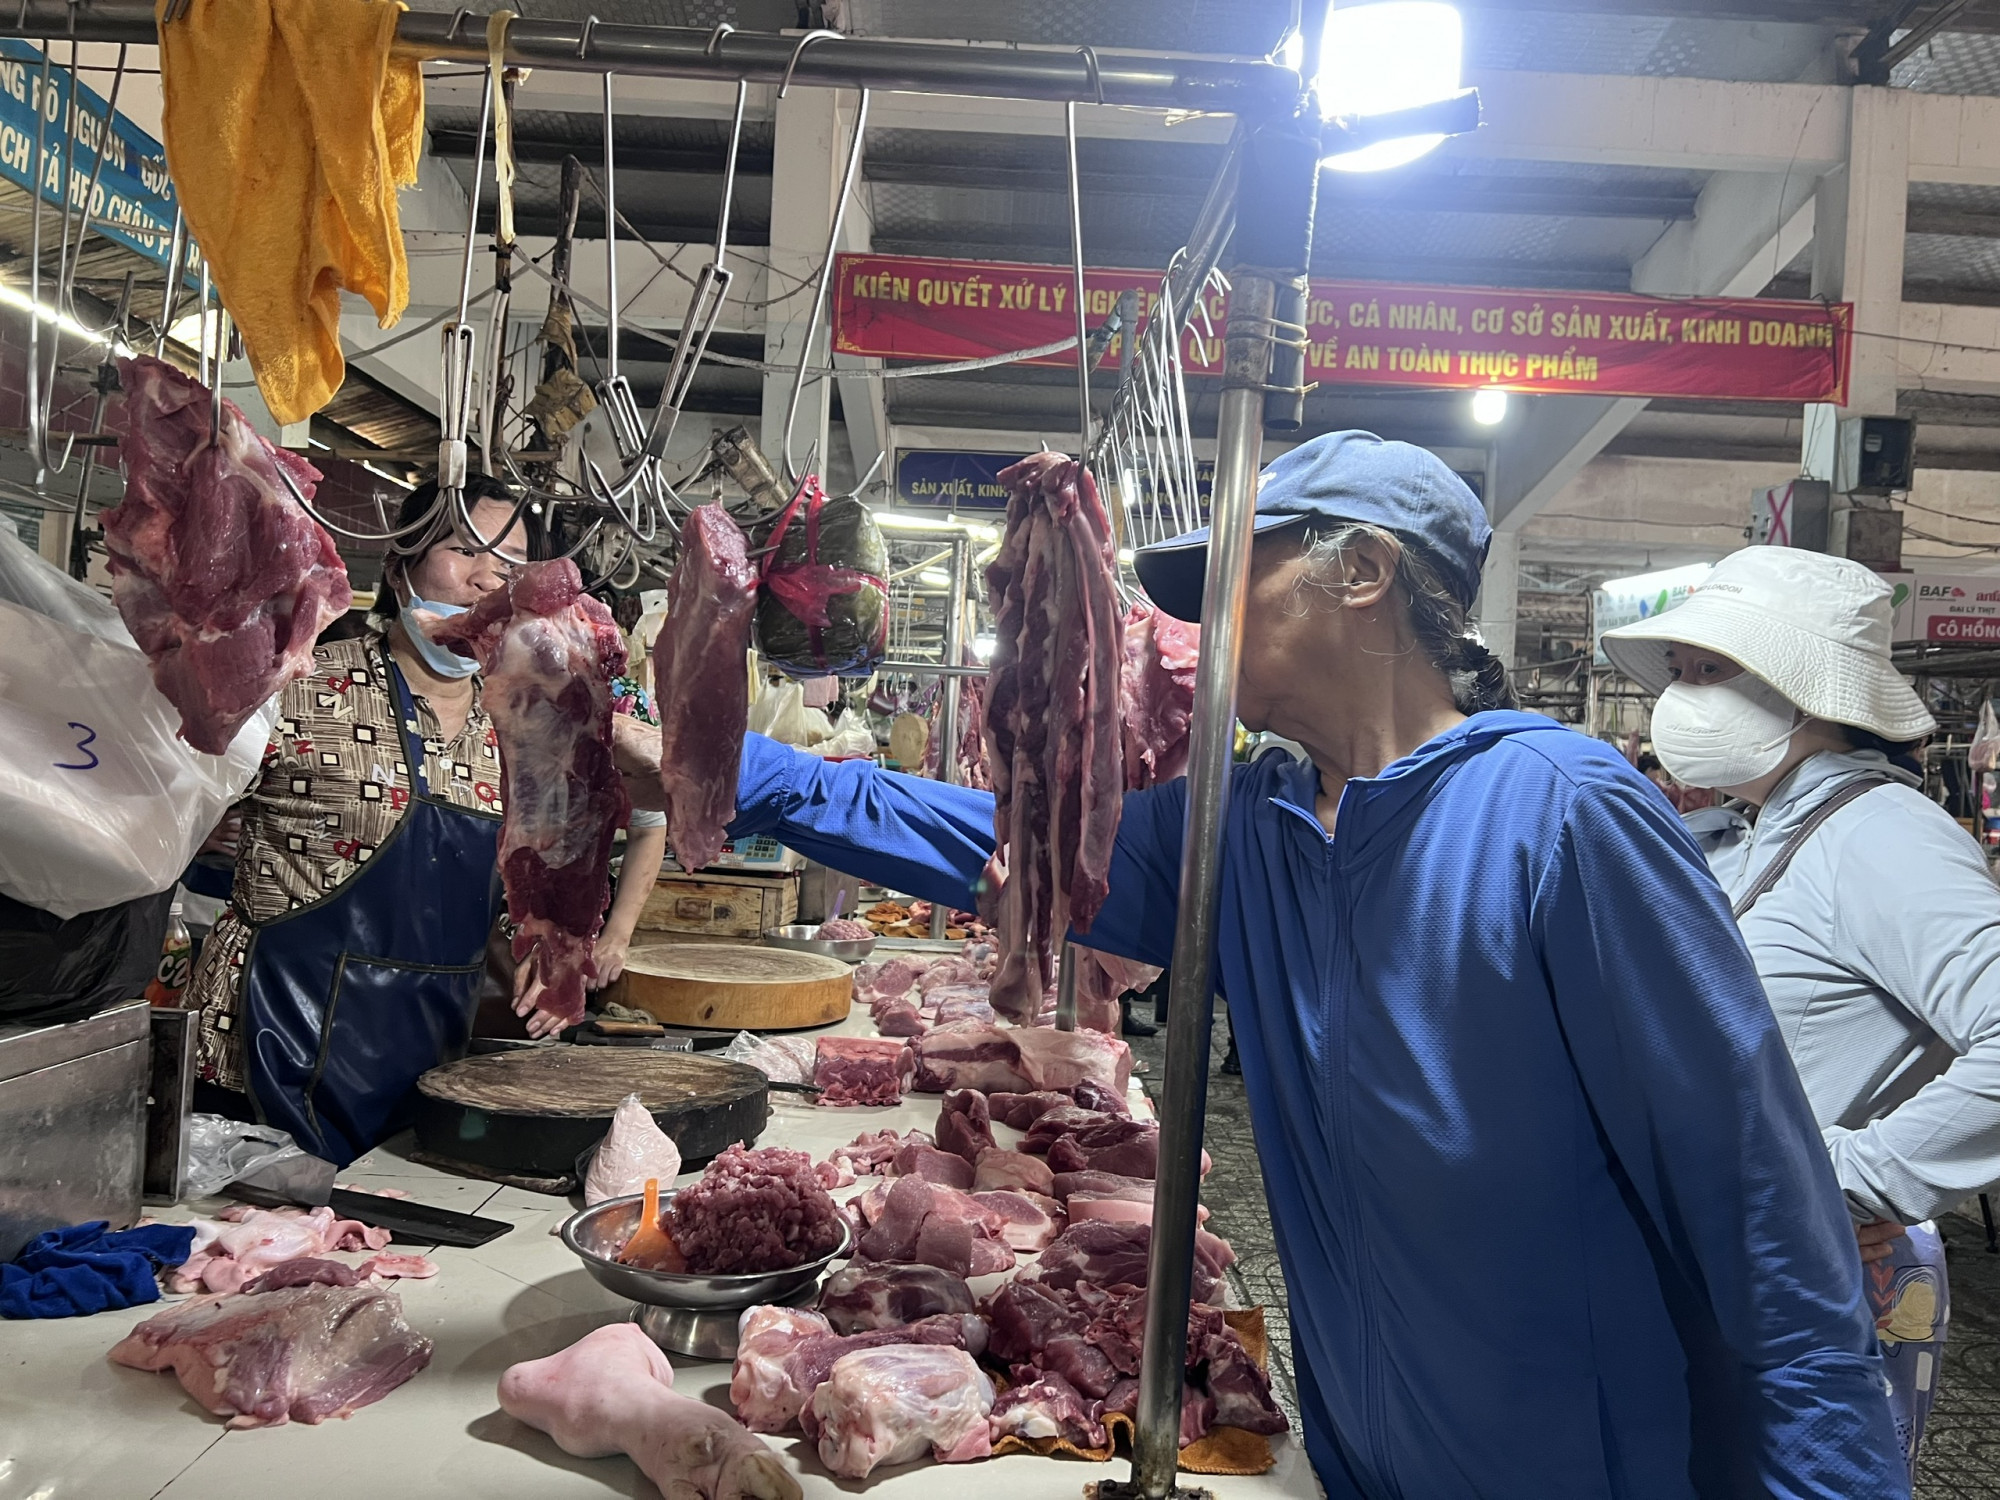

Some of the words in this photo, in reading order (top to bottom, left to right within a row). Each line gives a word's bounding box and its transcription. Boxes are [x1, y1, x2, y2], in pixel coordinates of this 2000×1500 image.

[0, 55, 25, 104] NG
[853, 271, 910, 302] KIÊN
[917, 275, 993, 308] QUYẾT
[999, 278, 1034, 310] XỬ
[1038, 282, 1067, 312] LÝ
[1349, 298, 1380, 328] CÁ
[1389, 301, 1463, 335] NHÂN,
[1471, 307, 1505, 334] CƠ
[1510, 303, 1544, 336] SỞ
[1551, 305, 1600, 339] SẢN
[1608, 309, 1673, 344] XUẤT,
[1682, 318, 1740, 345] KINH
[1748, 321, 1833, 348] DOANH
[1309, 336, 1338, 369] VỀ
[1344, 345, 1379, 370] AN
[1387, 343, 1450, 374] TOÀN
[1457, 350, 1518, 383] THỰC
[1526, 346, 1598, 382] PHẨM
[911, 478, 937, 495] SẢN
[1920, 585, 1951, 597] BAF
[1937, 619, 1958, 637] CÔ
[53, 722, 99, 770] 3
[157, 955, 190, 987] C2
